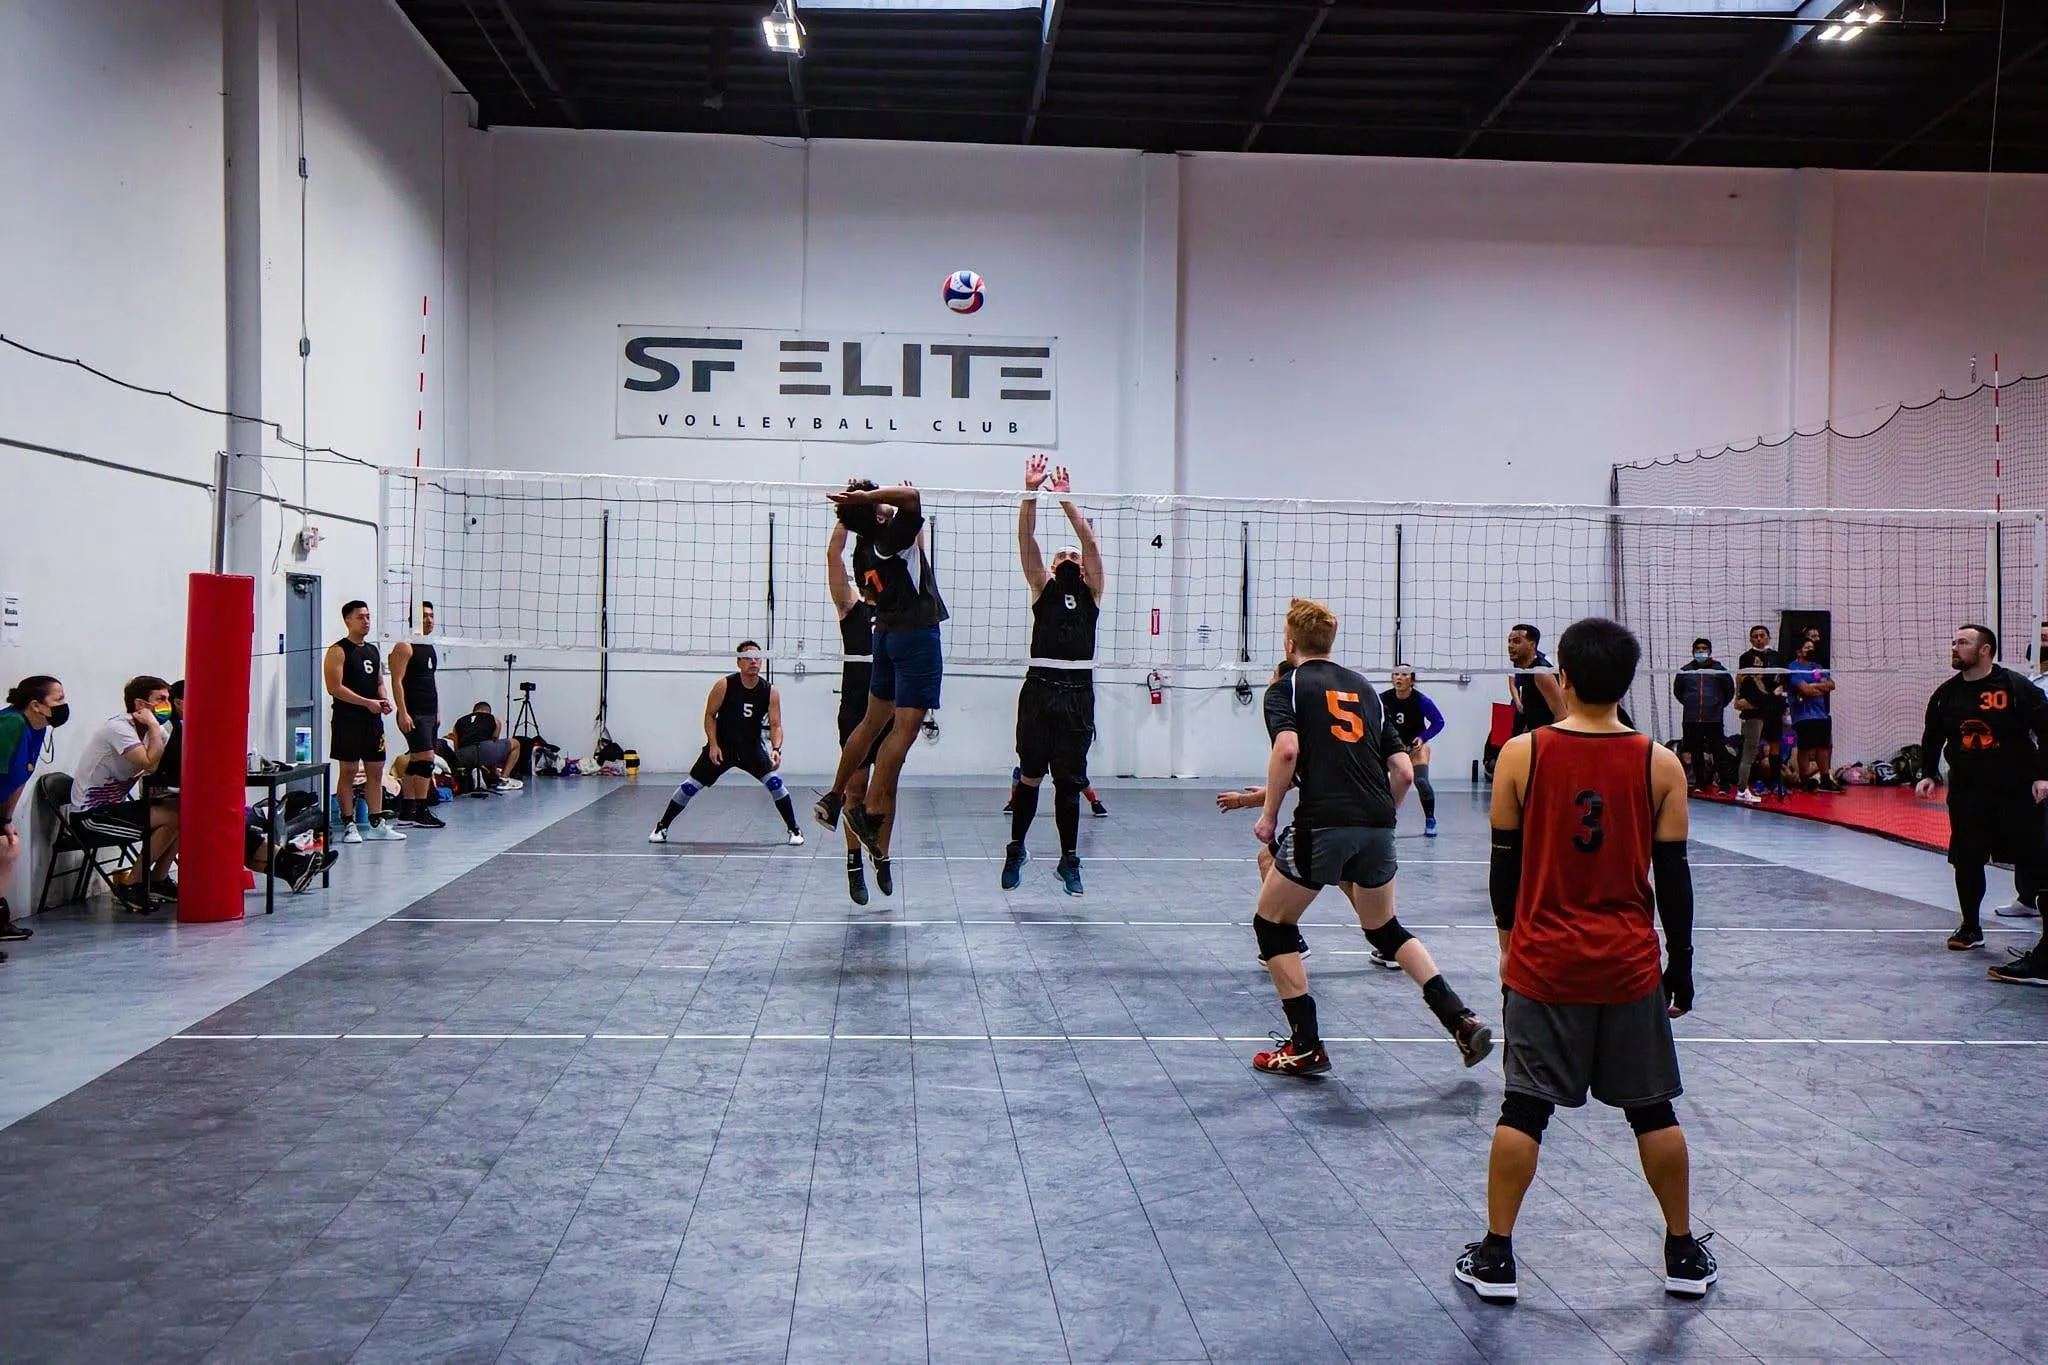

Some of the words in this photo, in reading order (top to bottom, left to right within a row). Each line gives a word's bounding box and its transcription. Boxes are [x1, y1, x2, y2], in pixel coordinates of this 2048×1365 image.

[624, 337, 742, 392] SF
[780, 341, 1051, 400] ELITE
[658, 413, 898, 432] VOLLEYBALL
[932, 419, 1018, 434] CLUB
[1151, 534, 1163, 549] 4
[363, 659, 374, 674] 6
[1979, 689, 2008, 710] 30
[743, 703, 754, 718] 5
[1325, 690, 1364, 743] 5
[1396, 712, 1405, 724] 3
[1573, 788, 1604, 853] 3
